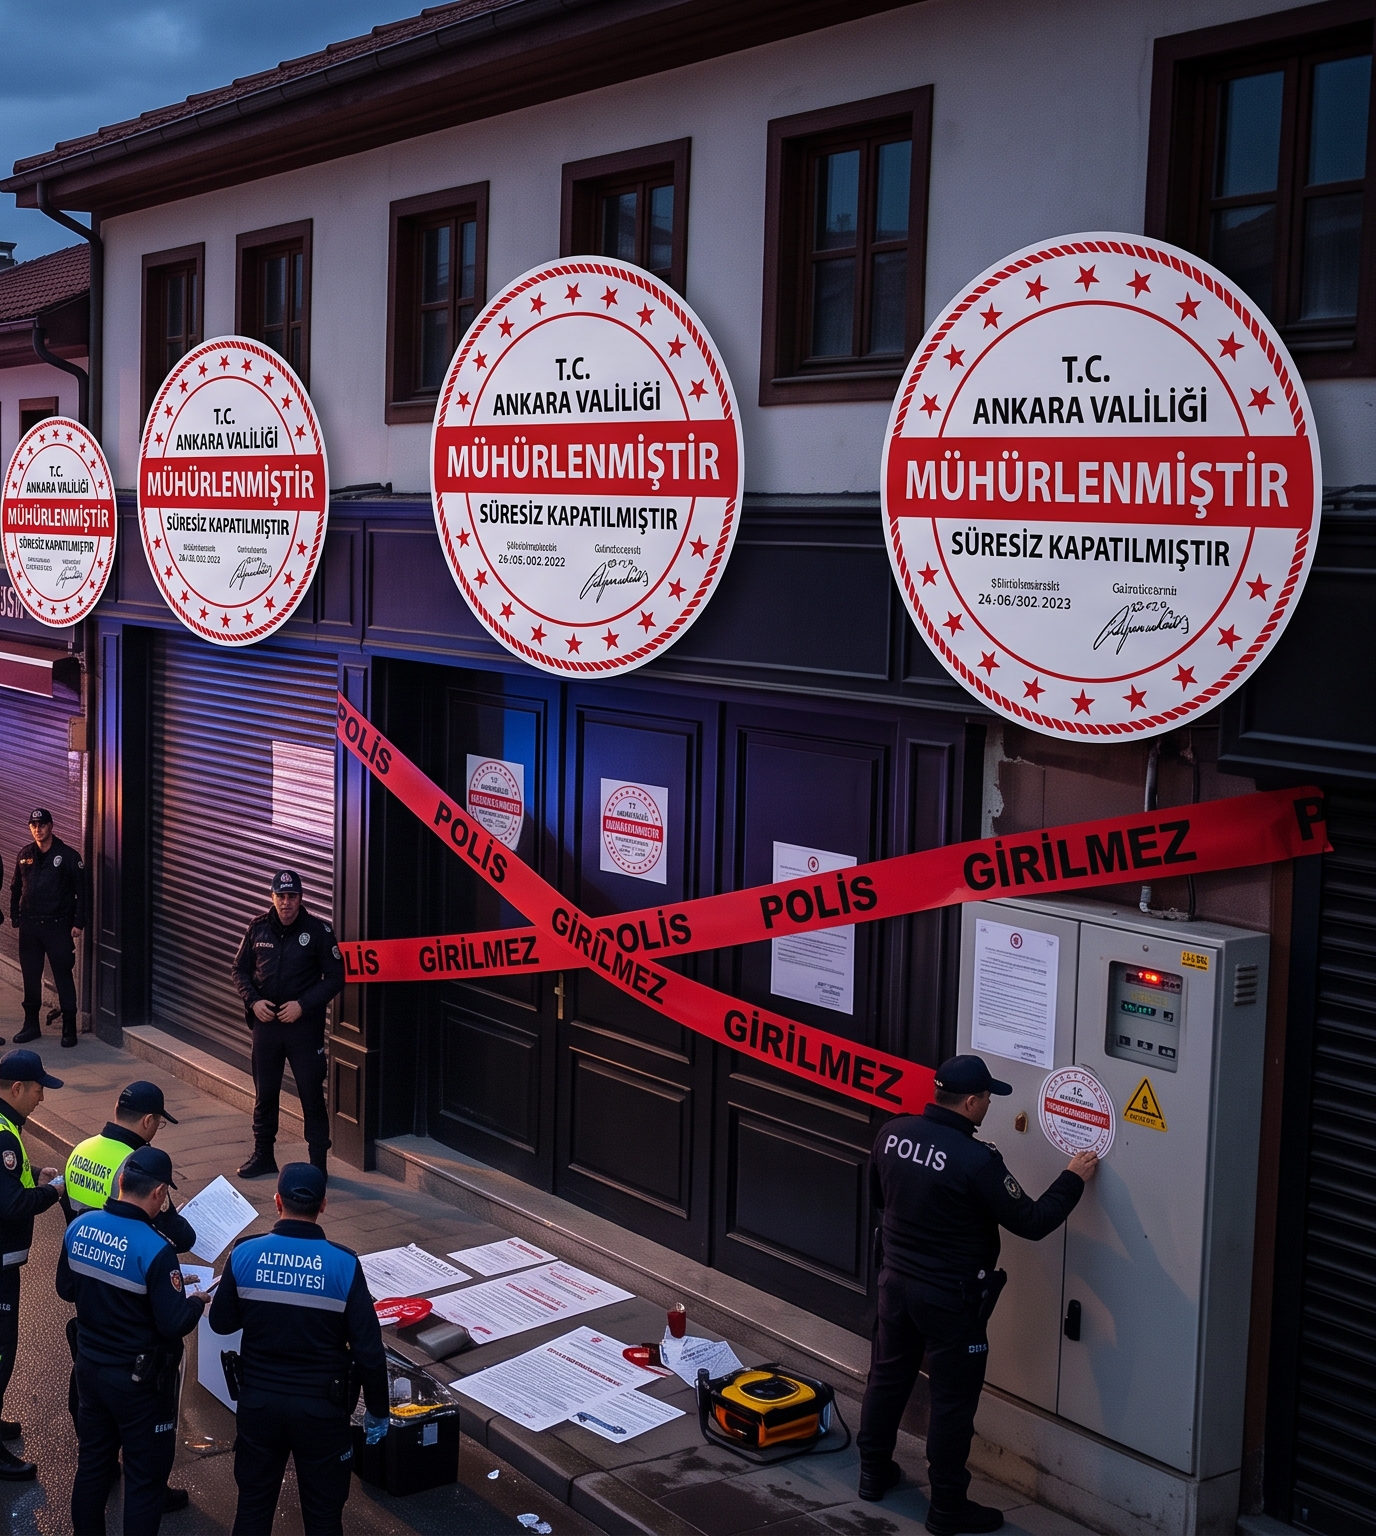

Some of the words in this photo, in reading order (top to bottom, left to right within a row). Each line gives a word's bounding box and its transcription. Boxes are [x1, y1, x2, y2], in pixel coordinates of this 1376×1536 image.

[555, 356, 590, 381] T.C.
[1062, 354, 1111, 383] T.C.
[493, 390, 571, 416] ANKARA
[576, 380, 661, 413] VALİLİĞİ
[973, 396, 1084, 424] ANKARA
[1090, 386, 1208, 423] VALİLİĞİ
[213, 408, 235, 426] T.C.
[176, 432, 223, 451] ANKARA
[226, 425, 279, 449] VALİLİĞİ
[49, 465, 63, 478] T.C.
[447, 432, 720, 491] MÜHÜRLENMİŞTİR
[26, 481, 56, 494] ANKARA
[147, 463, 315, 507] MÜHÜRLENMİŞTİR
[905, 450, 1290, 519] MÜHÜRLENMİŞTİR
[7, 504, 109, 533] MÜHÜRLENMİŞTİR
[167, 513, 207, 532] SÜRESİZ
[209, 517, 290, 539] KAPATILMIŞTIR
[480, 499, 544, 526] SÜRESİZ
[547, 506, 678, 535] KAPATILMIŞTIR
[950, 526, 1044, 559] SÜRESİZ
[1048, 533, 1231, 572] KAPATILMIŞTIR
[337, 702, 393, 775] POLİS
[434, 800, 508, 883] POLİS
[551, 907, 668, 1005] GİRİLMEZ
[724, 1010, 904, 1106] GİRİLMEZ
[344, 945, 380, 976] LİS
[419, 936, 540, 972] GİRİLMEZ
[759, 873, 878, 929] POLİS
[963, 819, 1198, 892] GİRİLMEZ
[884, 1134, 947, 1172] POLİS
